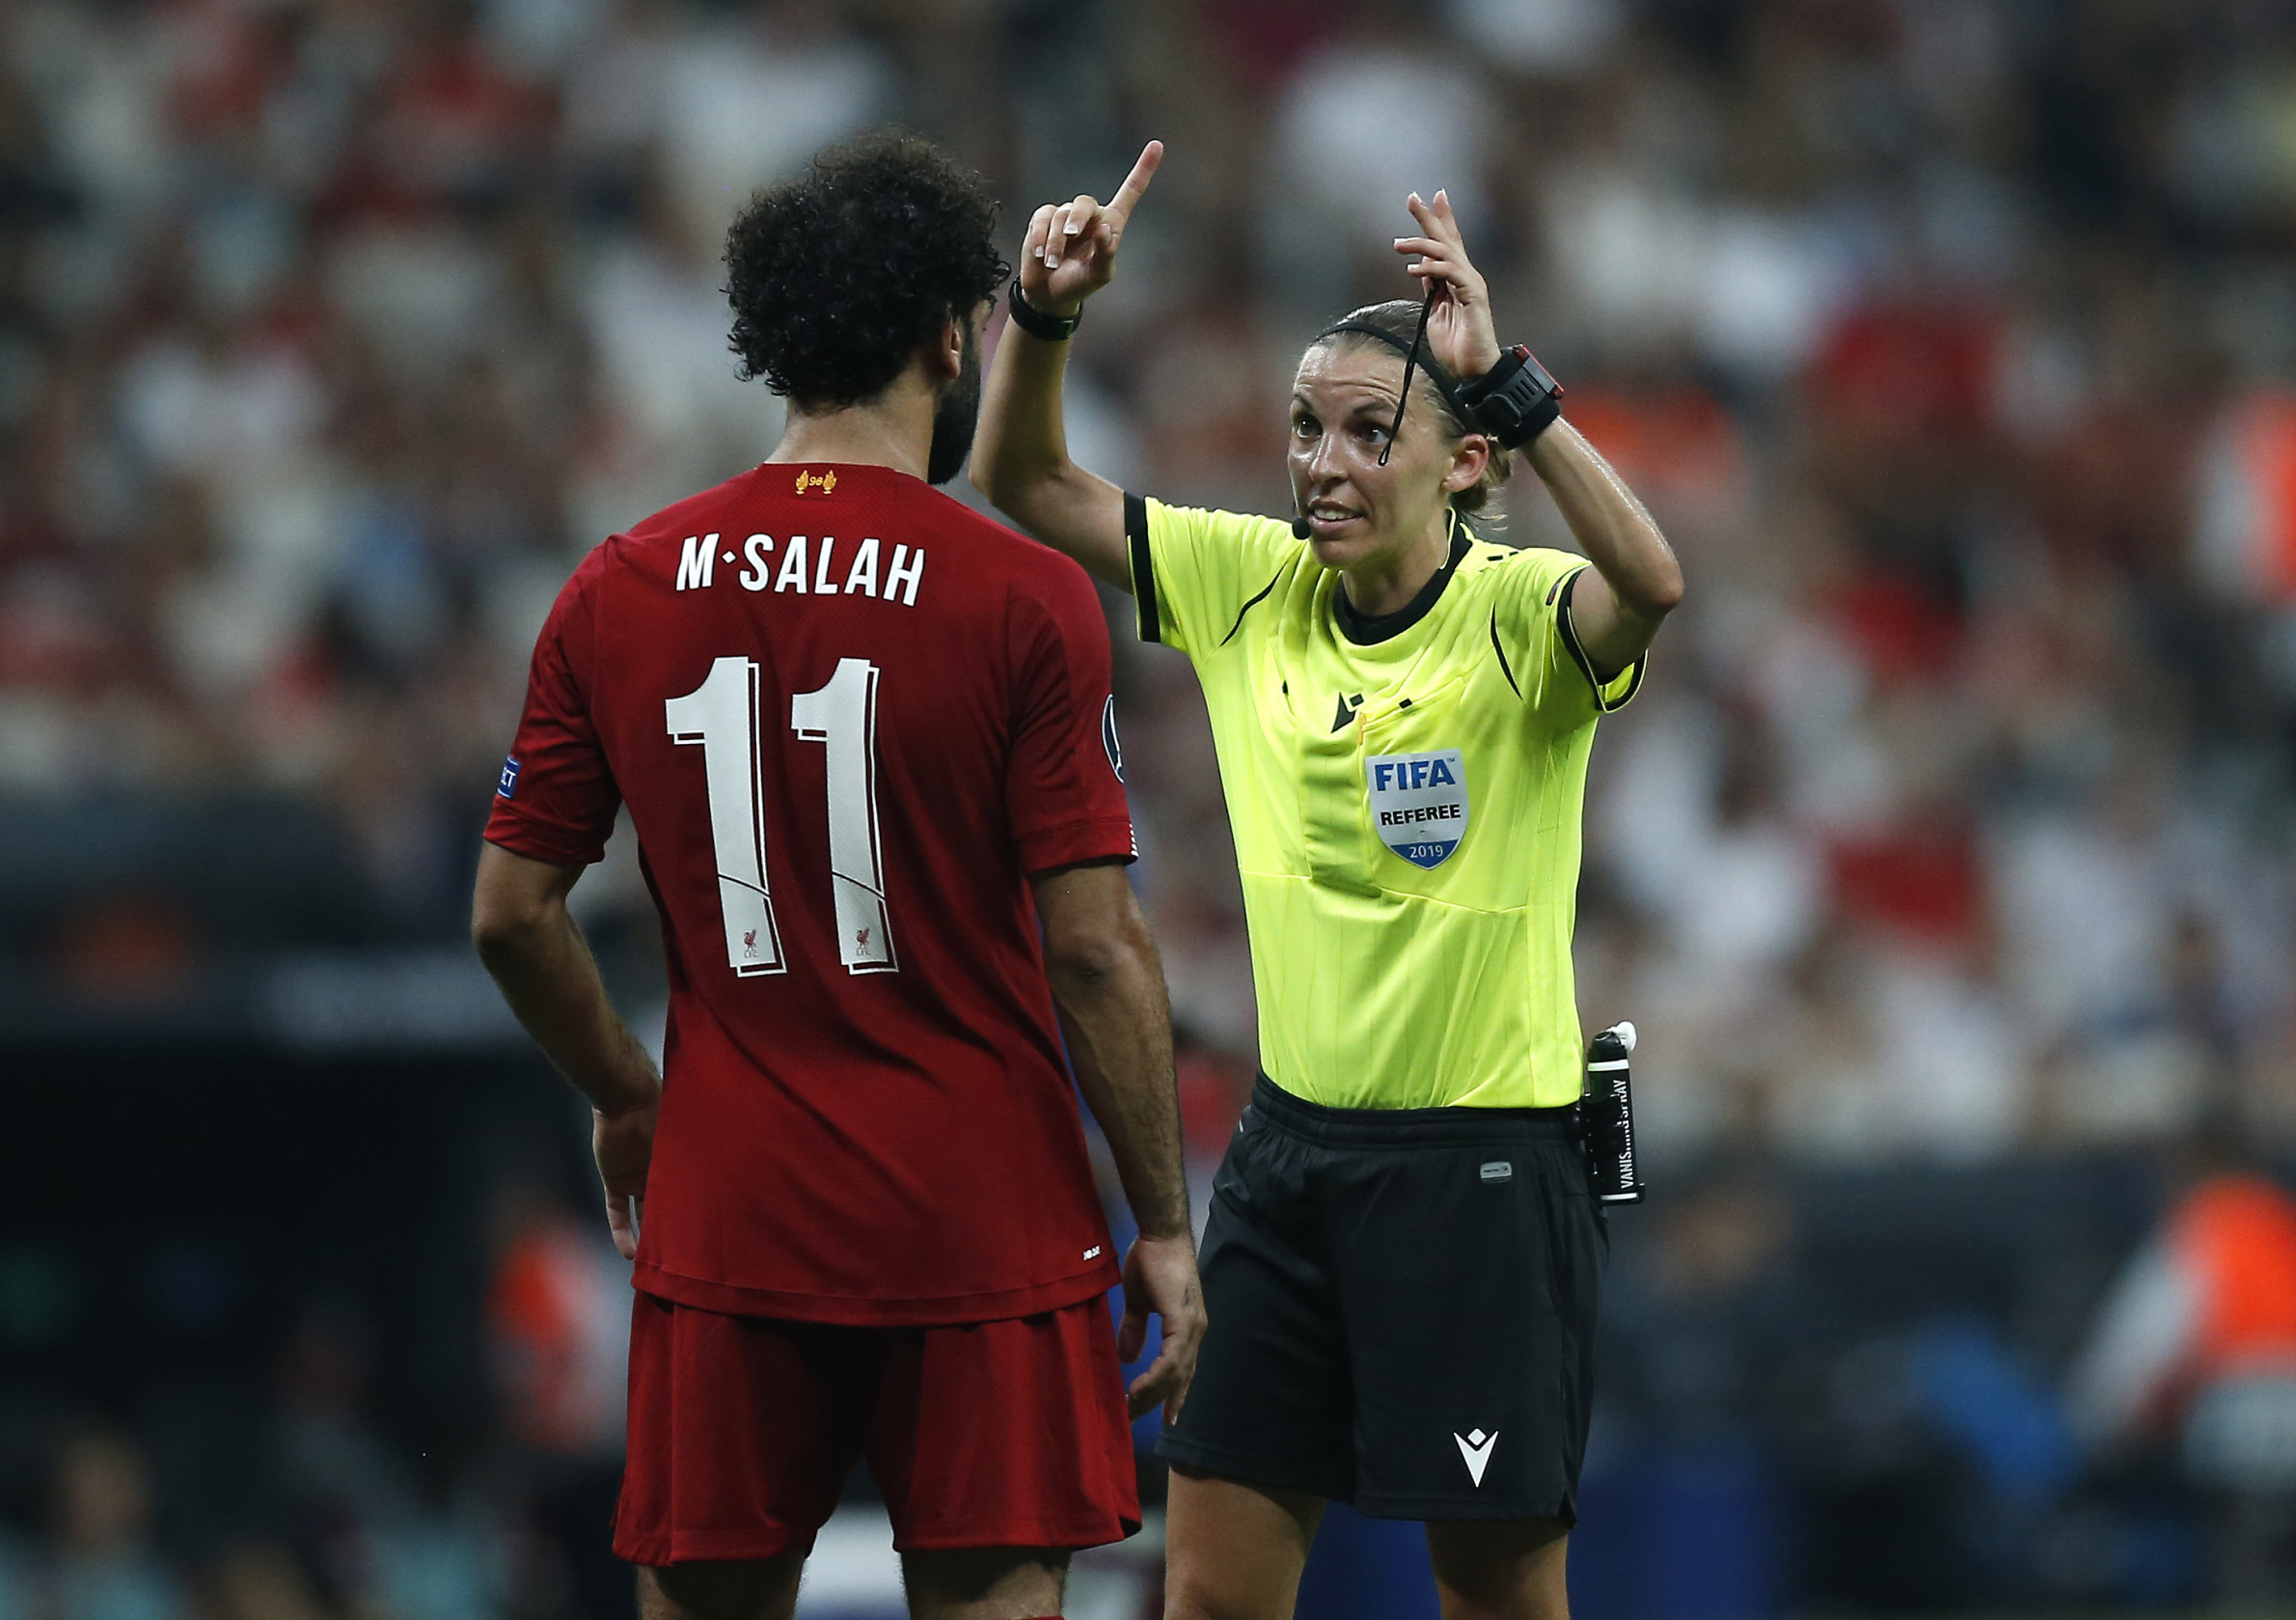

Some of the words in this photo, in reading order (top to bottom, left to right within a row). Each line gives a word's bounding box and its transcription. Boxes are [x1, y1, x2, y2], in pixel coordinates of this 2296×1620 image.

[1375, 758, 1456, 791] FIFA
[665, 656, 899, 977] 11
[1380, 804, 1461, 826] REFEREE
[1409, 845, 1444, 858] 2019
